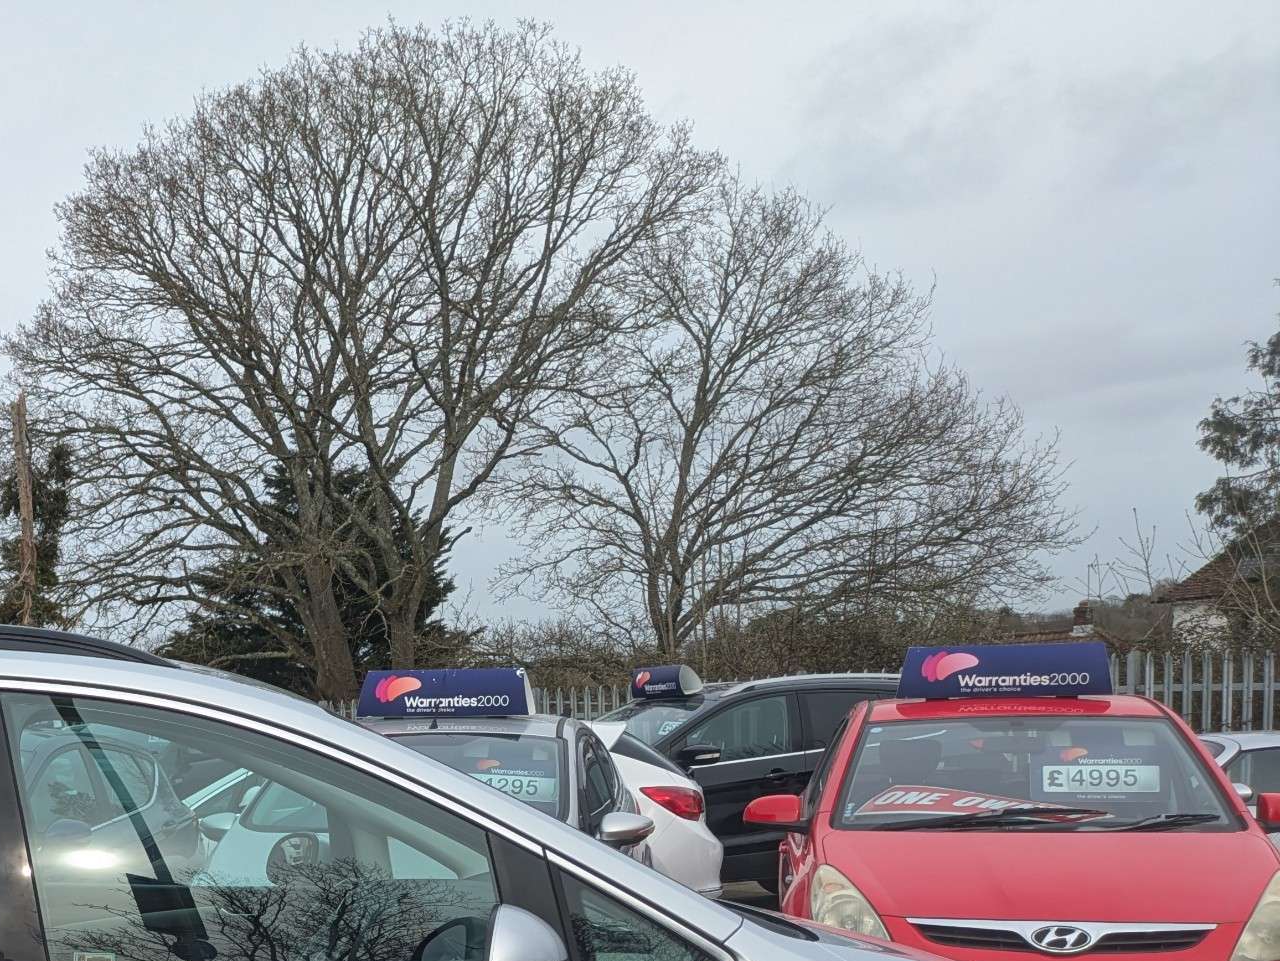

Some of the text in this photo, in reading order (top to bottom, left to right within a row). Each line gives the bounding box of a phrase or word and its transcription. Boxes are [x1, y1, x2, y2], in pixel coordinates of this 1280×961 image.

[958, 672, 1090, 687] Warranties2000
[404, 695, 509, 708] Warranties2000
[874, 791, 949, 806] ONE
